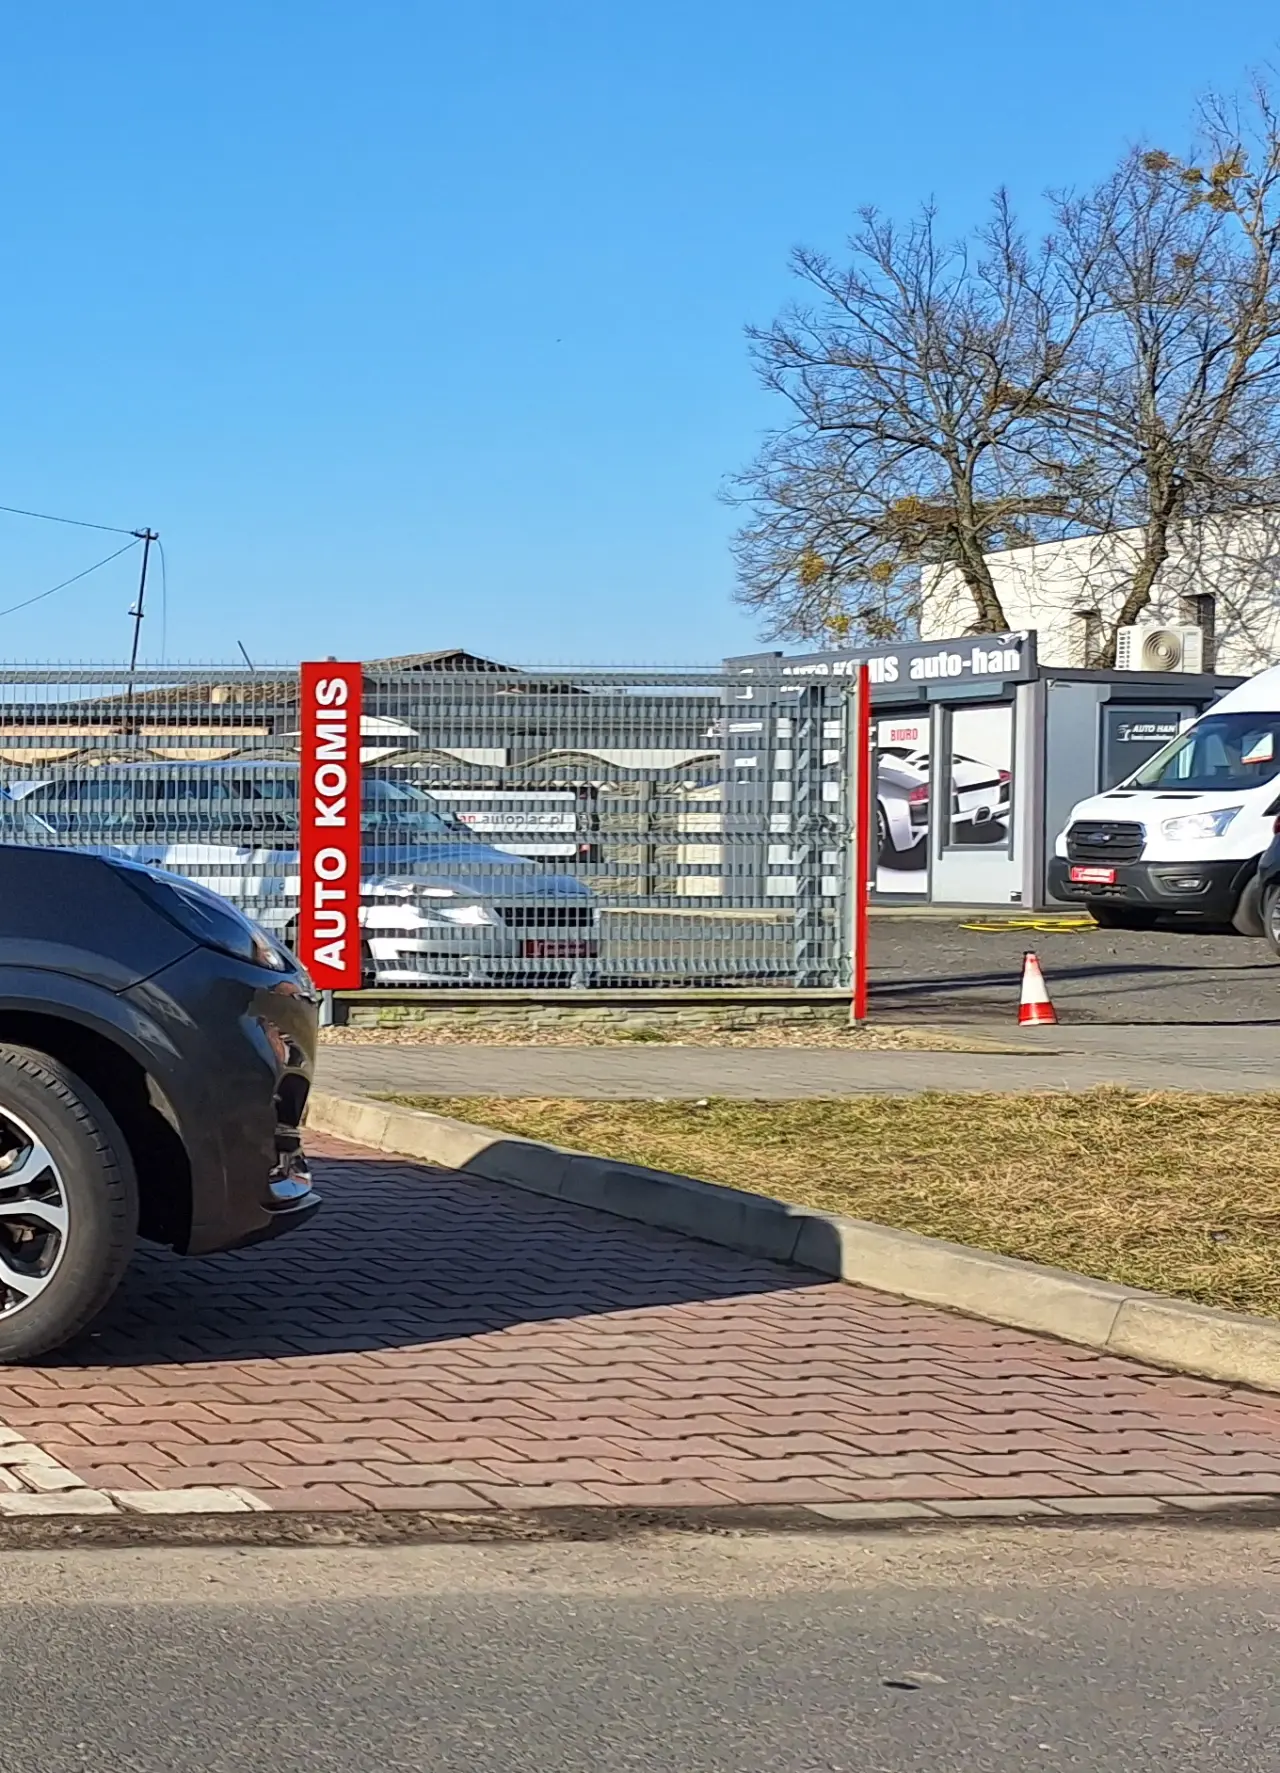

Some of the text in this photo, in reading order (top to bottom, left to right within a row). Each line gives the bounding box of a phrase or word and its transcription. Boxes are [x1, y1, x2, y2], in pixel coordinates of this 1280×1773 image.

[910, 648, 1020, 680] auto-han
[890, 728, 918, 741] BIURO
[1132, 724, 1155, 732] AUTO
[314, 678, 348, 970] AUTO KOMIS
